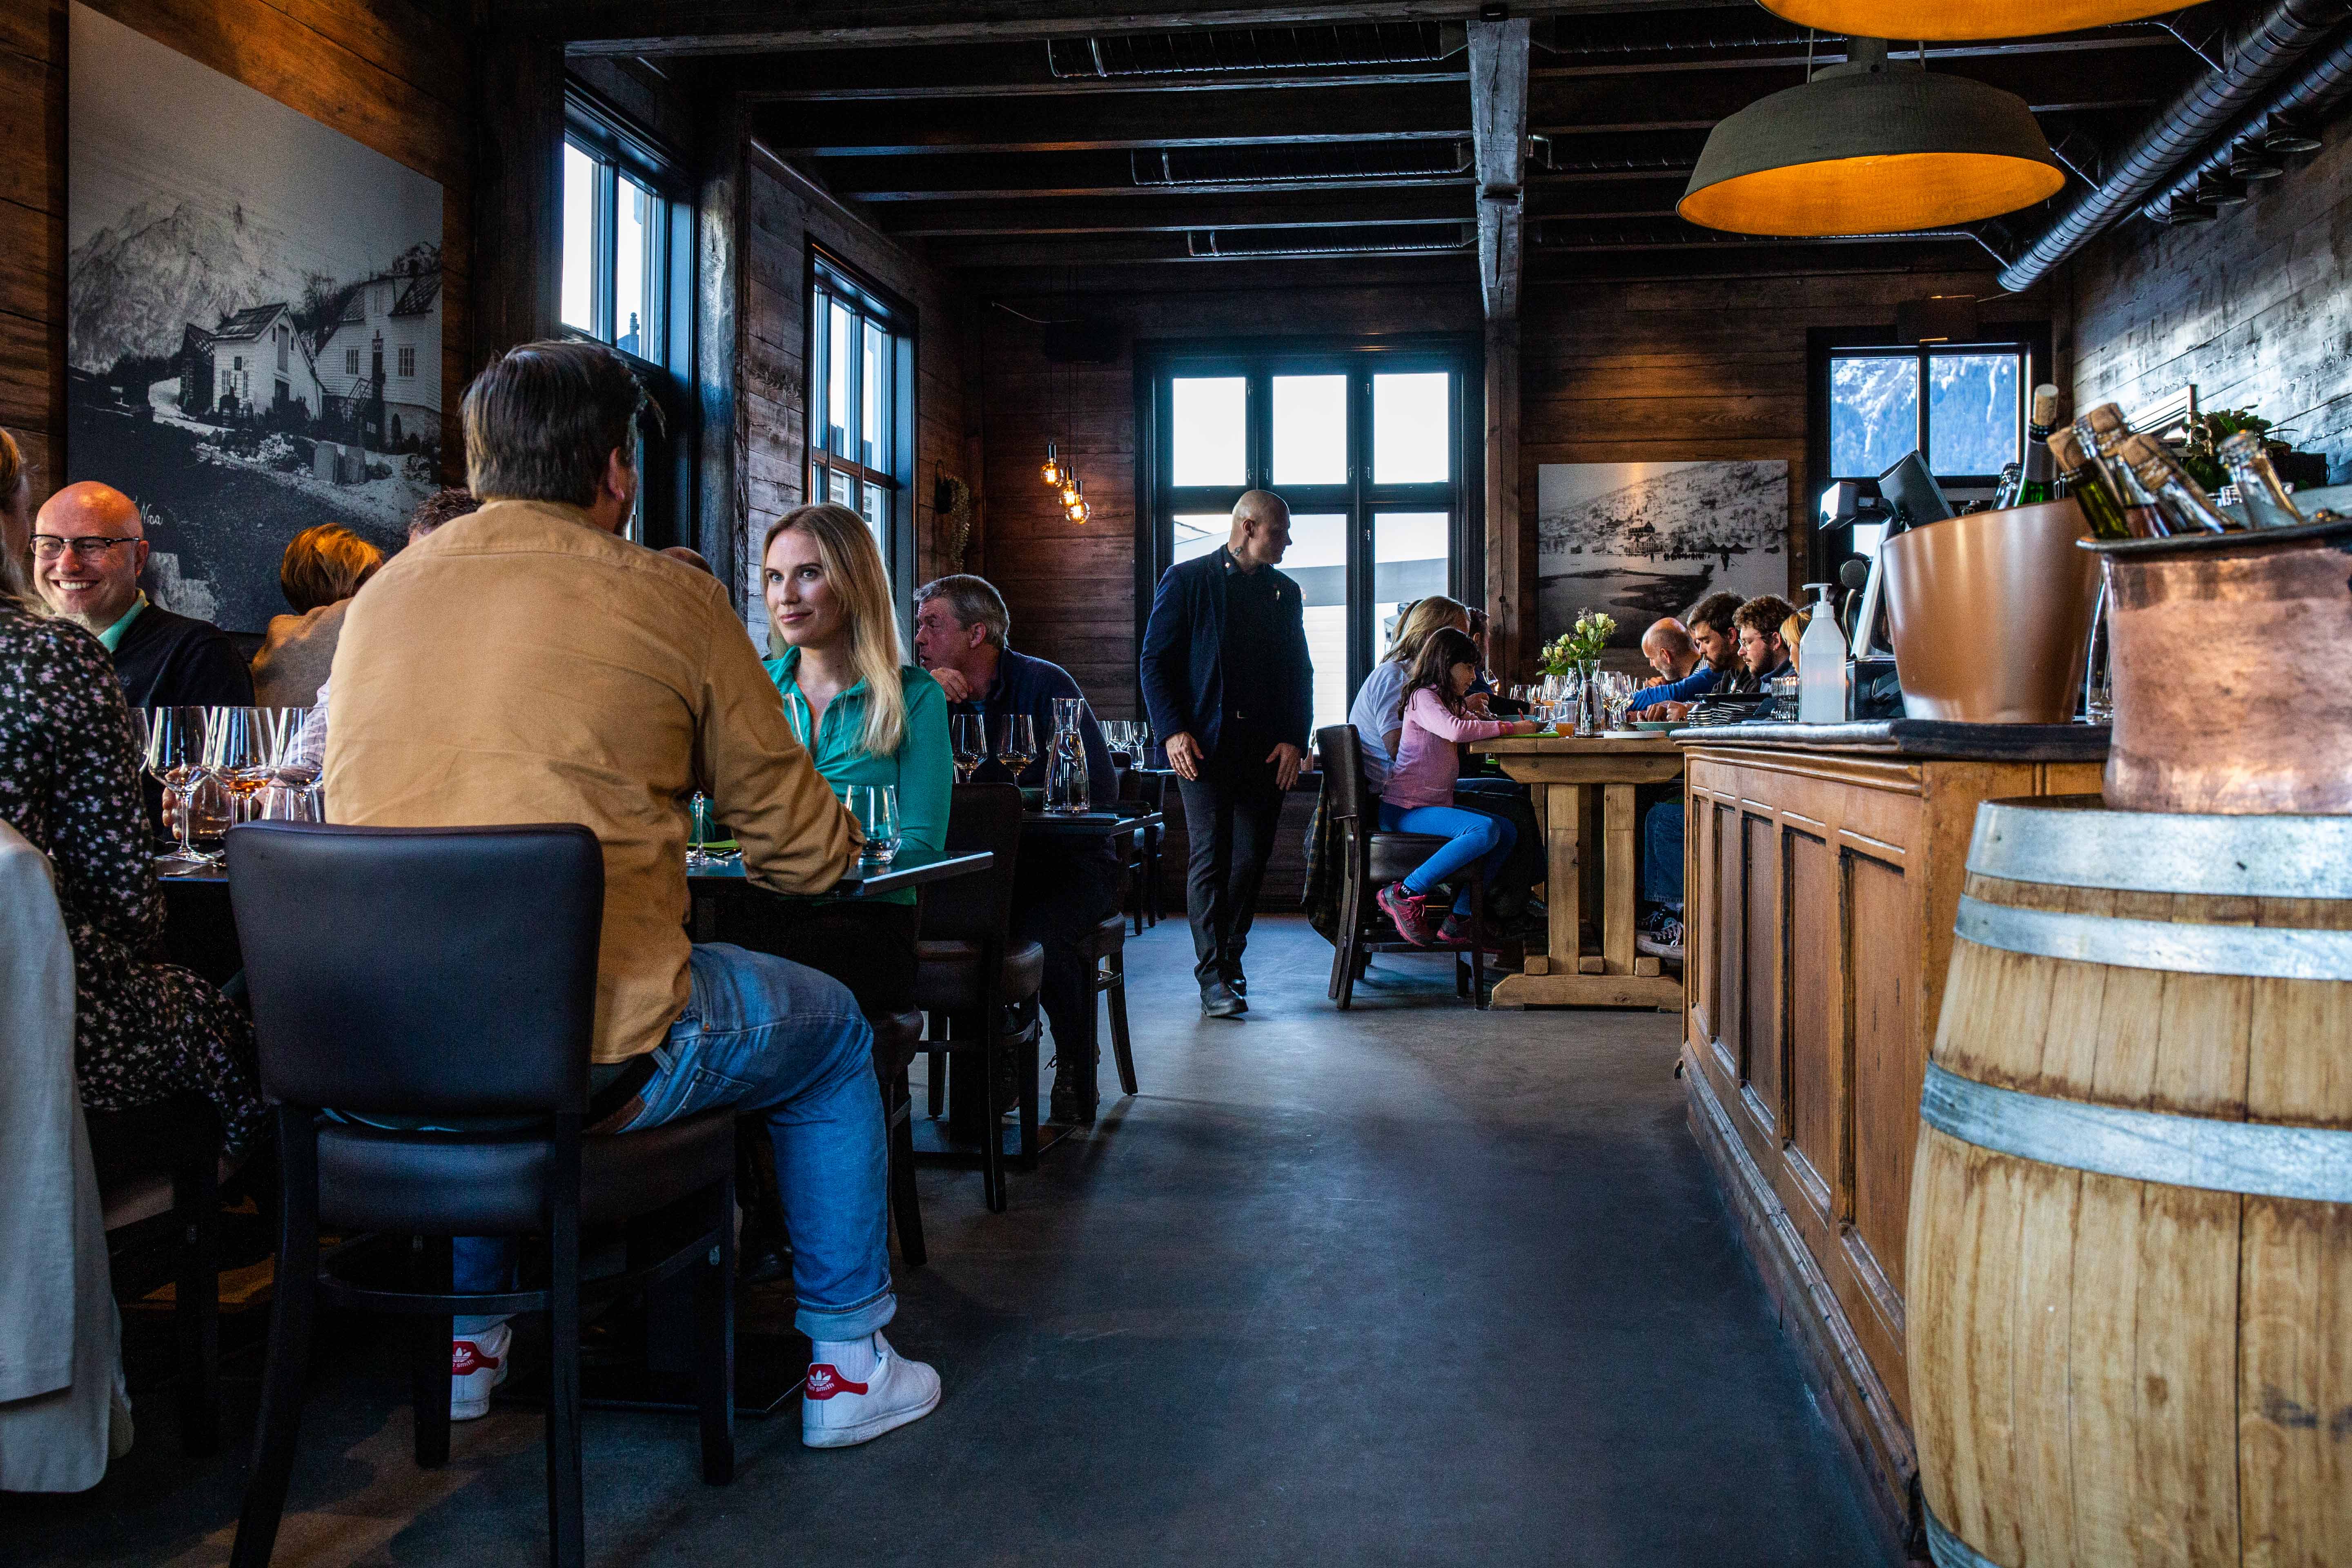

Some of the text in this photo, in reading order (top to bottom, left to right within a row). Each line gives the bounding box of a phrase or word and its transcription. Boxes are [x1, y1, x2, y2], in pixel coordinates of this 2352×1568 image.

[1401, 885, 1410, 895] HH
[457, 1359, 474, 1368] smith
[816, 1383, 834, 1392] smith
